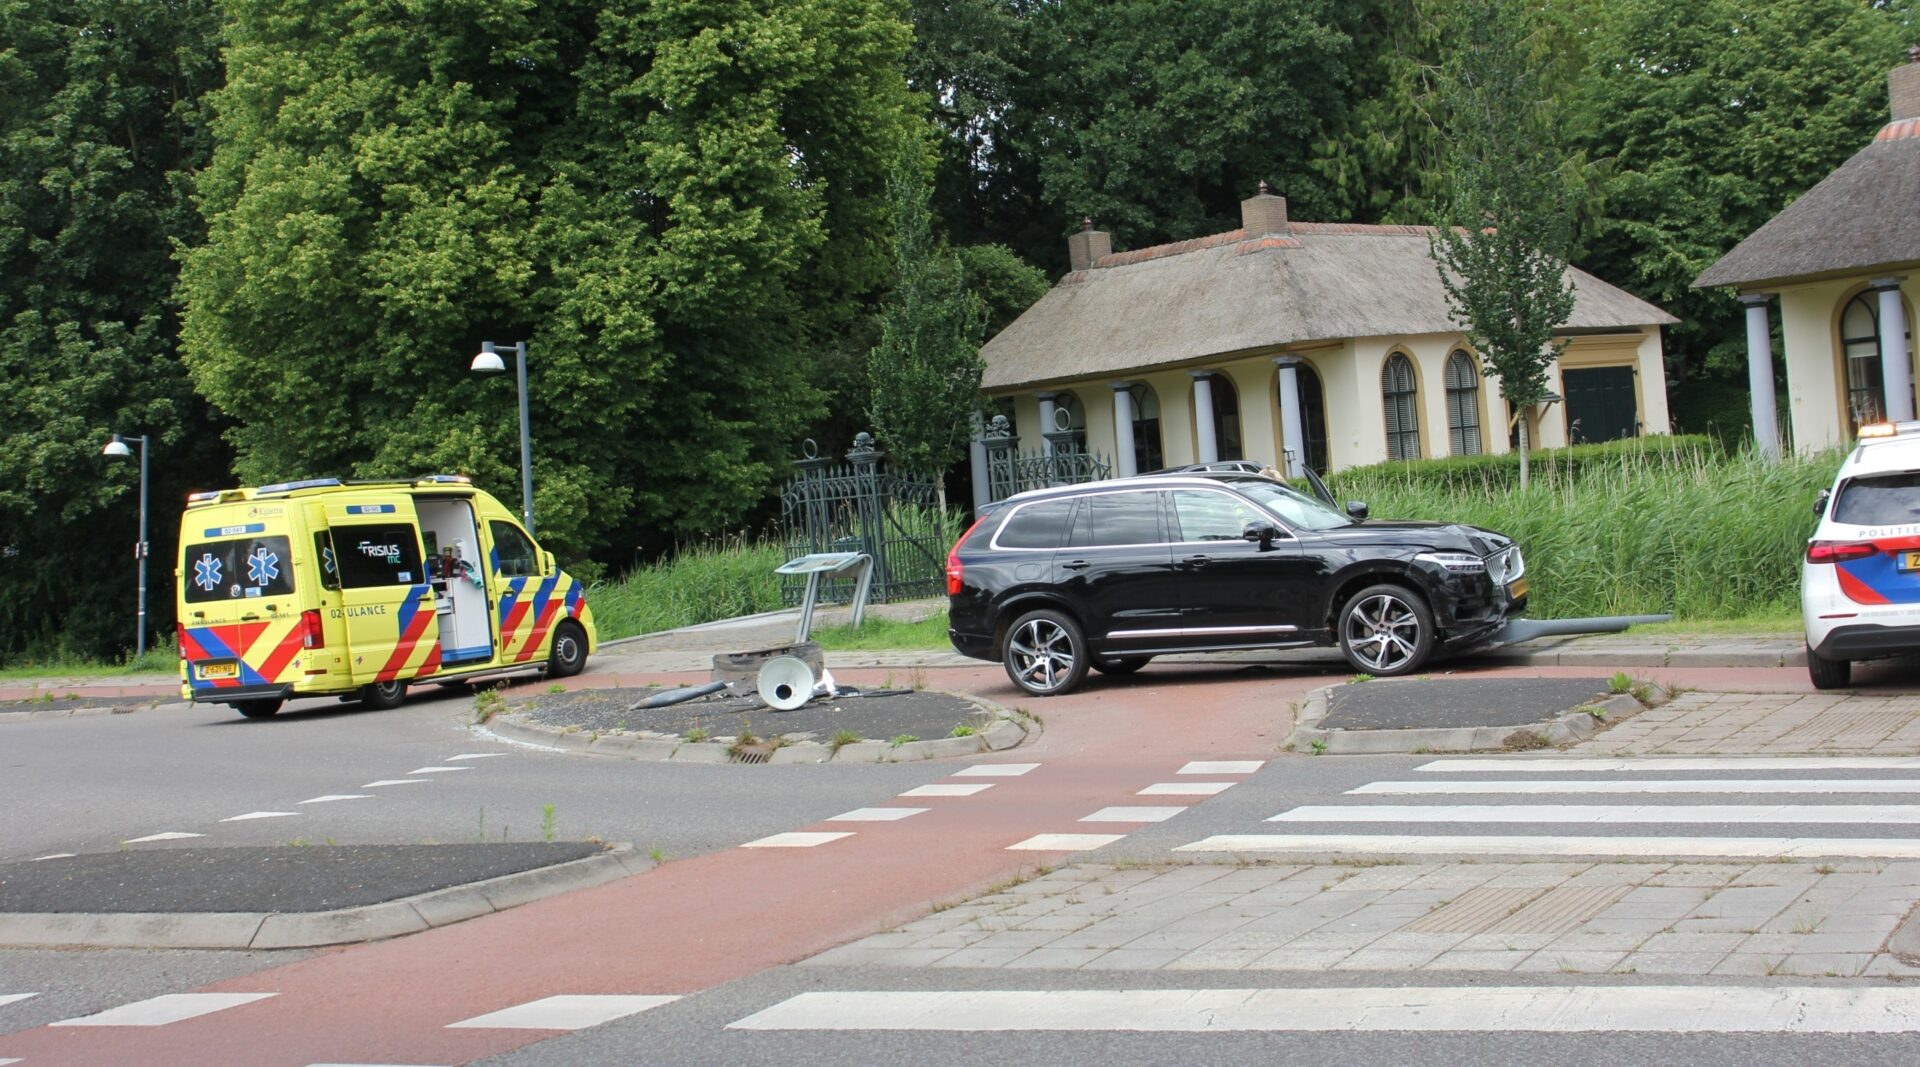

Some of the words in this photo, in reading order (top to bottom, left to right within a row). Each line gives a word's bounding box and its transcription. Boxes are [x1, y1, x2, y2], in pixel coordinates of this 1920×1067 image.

[1859, 526, 1920, 538] POLITIE
[357, 541, 400, 557] FRISIUS
[346, 605, 386, 618] ULANCE
[191, 618, 226, 626] AMBULANCE
